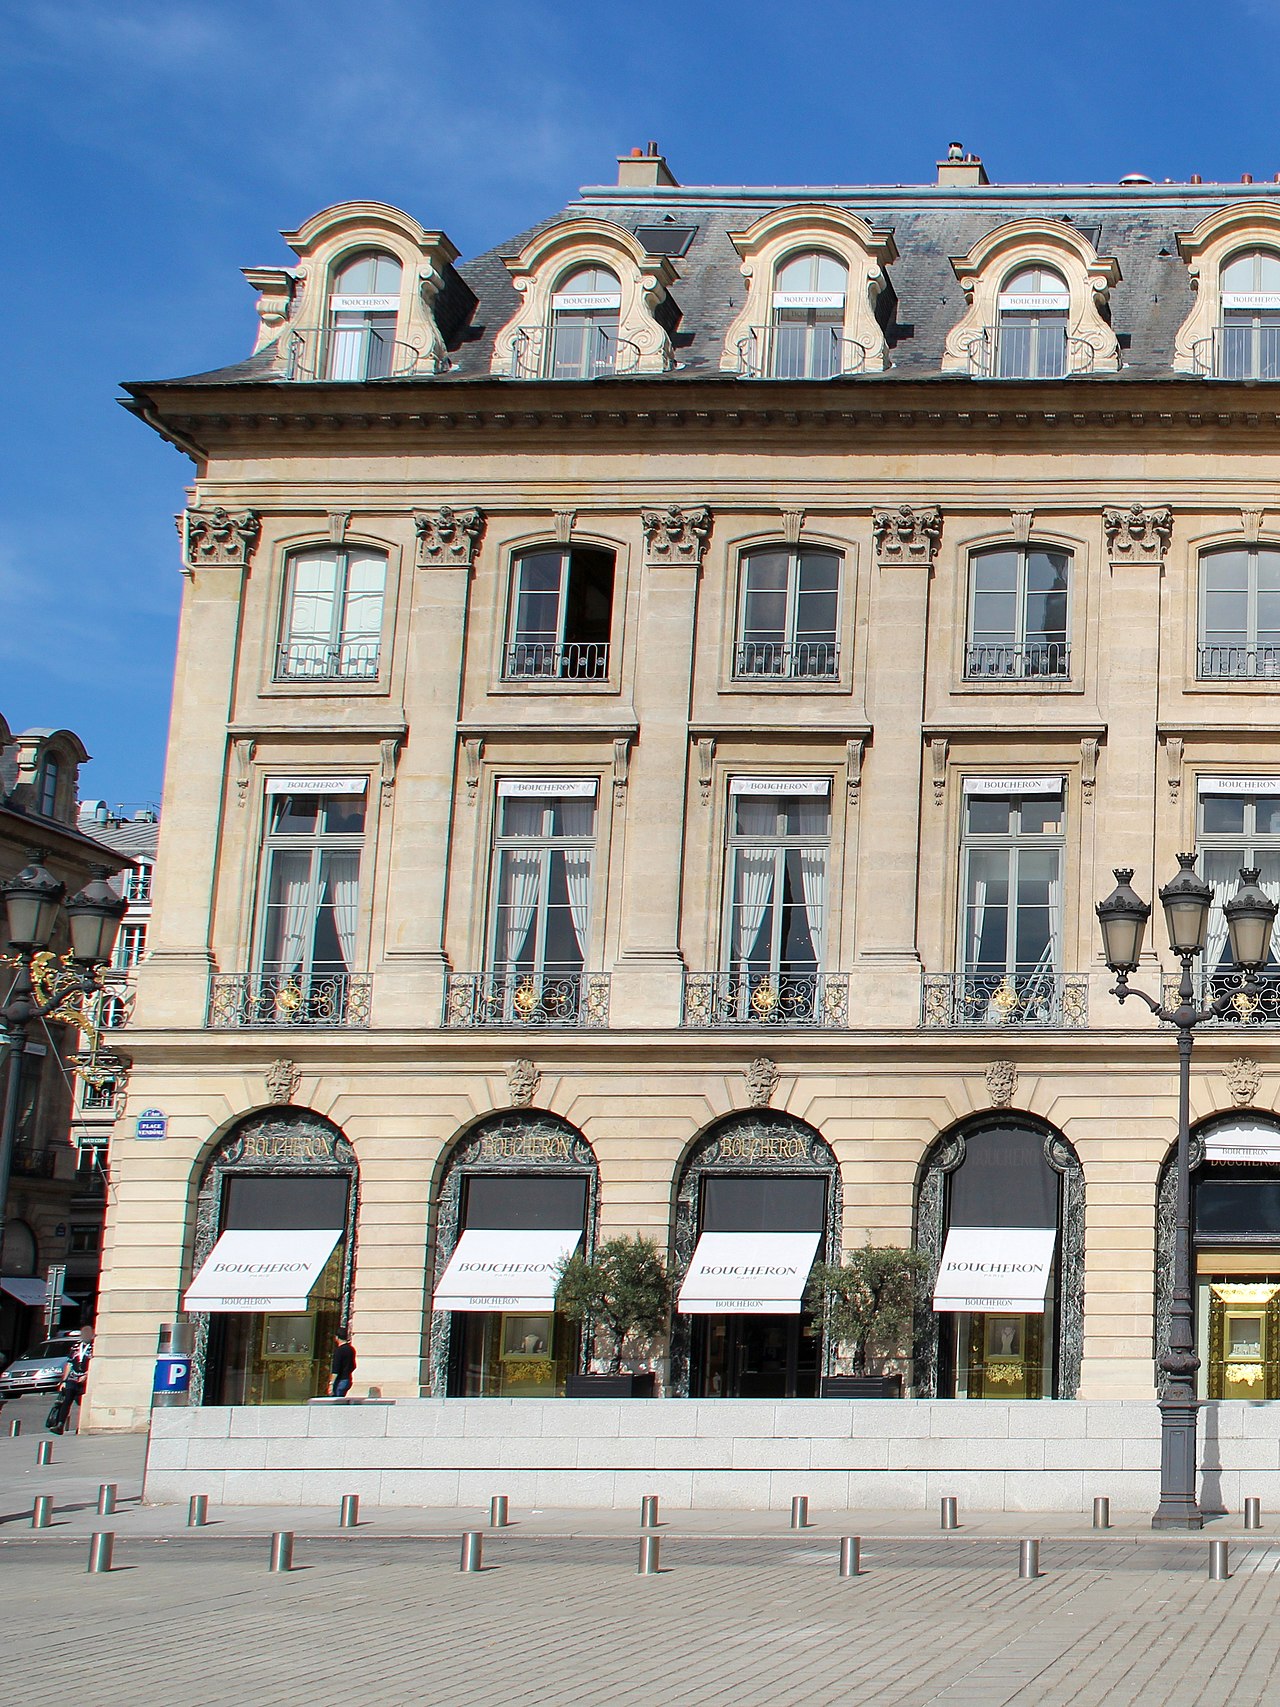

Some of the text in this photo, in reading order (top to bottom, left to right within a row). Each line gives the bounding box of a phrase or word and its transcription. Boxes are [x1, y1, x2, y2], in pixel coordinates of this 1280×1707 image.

[244, 1136, 330, 1157] BOUCHERON
[483, 1136, 571, 1157] BOUCHERON
[720, 1138, 809, 1158] BOUCHERON
[212, 1262, 313, 1273] BOUCHERON
[458, 1263, 555, 1273] BOUCHERON
[700, 1265, 798, 1276] BOUCHERON
[946, 1262, 1044, 1273] BOUCHERON
[168, 1363, 187, 1384] P
